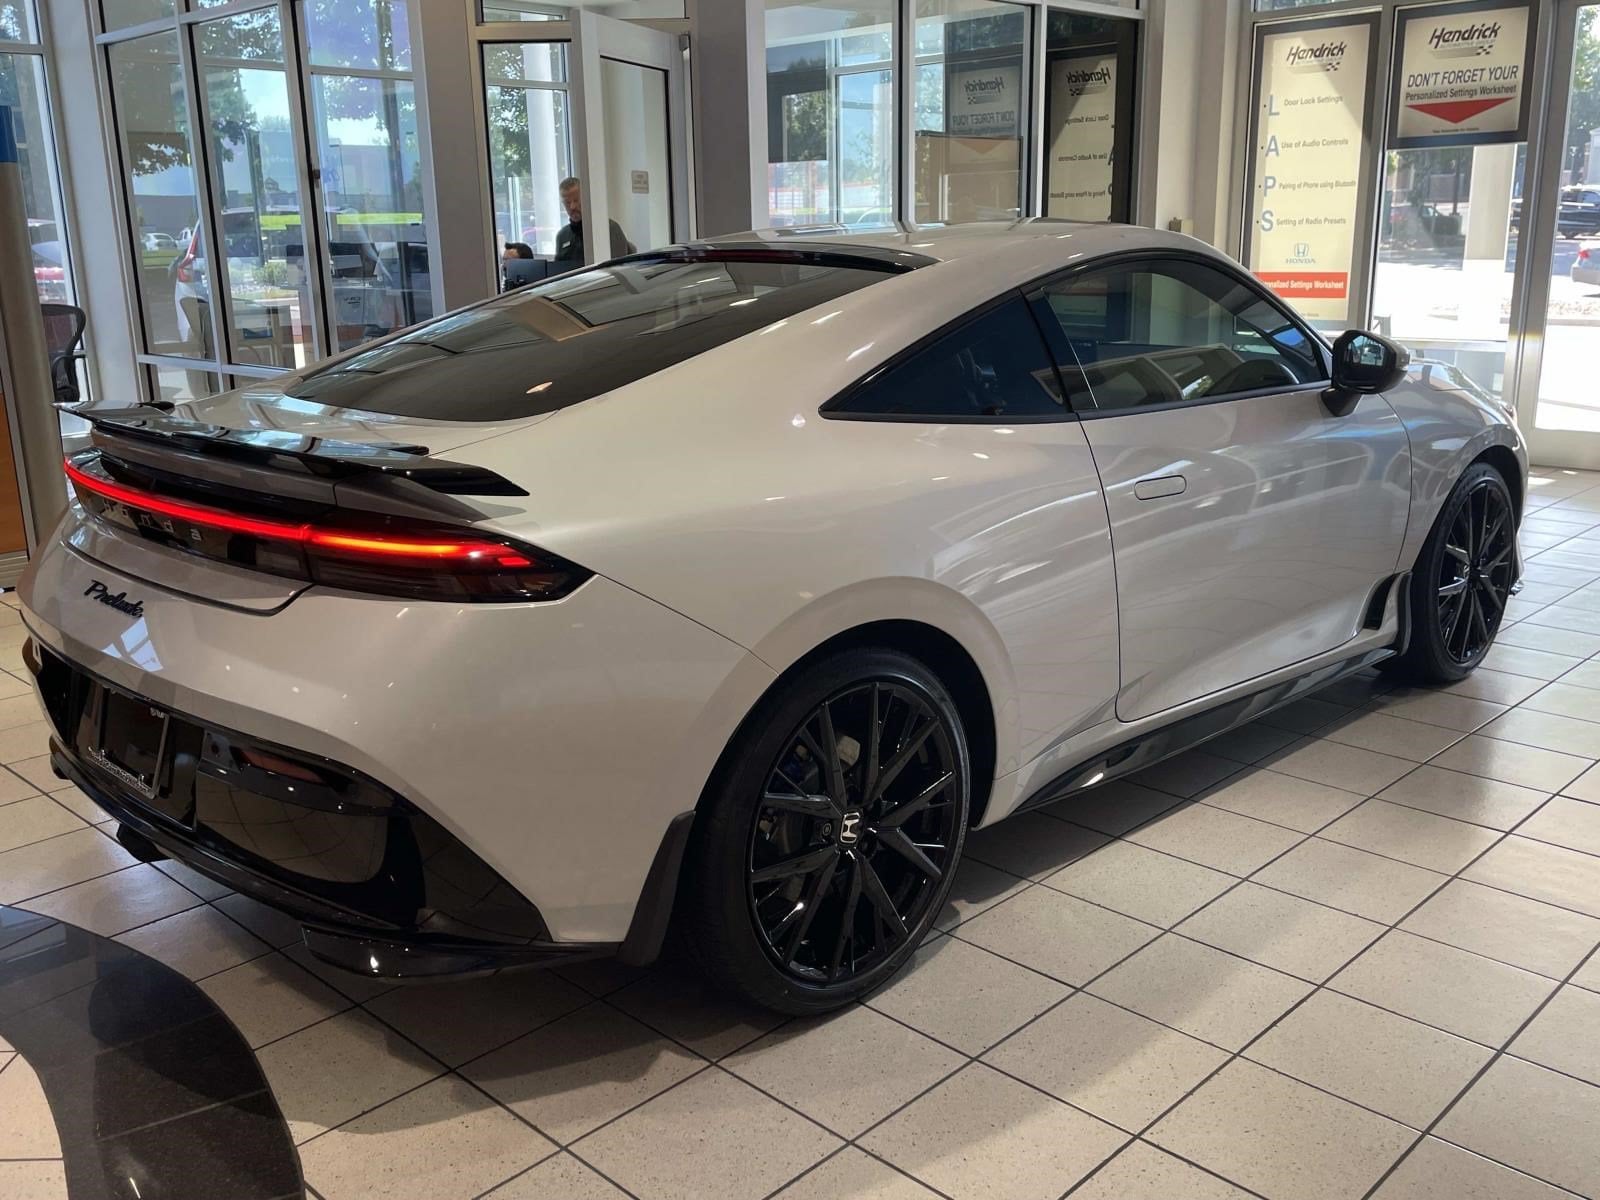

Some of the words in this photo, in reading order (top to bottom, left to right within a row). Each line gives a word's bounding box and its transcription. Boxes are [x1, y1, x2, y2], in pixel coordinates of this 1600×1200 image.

[1429, 22, 1501, 48] Hendrick
[1286, 41, 1347, 65] Hendrick
[1407, 72, 1440, 88] DON'T
[1441, 68, 1486, 85] FORGET
[1488, 65, 1519, 81] YOUR
[1284, 98, 1299, 106] Door
[1300, 97, 1315, 105] Lock
[1317, 95, 1343, 105] Settings
[1405, 90, 1448, 101] Personalized
[1449, 87, 1477, 98] Settings
[1479, 84, 1516, 95] Worksheet
[1268, 95, 1280, 116] L
[1265, 135, 1280, 158] A
[1321, 138, 1349, 146] Controls
[1263, 175, 1277, 198] P
[1261, 210, 1274, 232] S
[1276, 218, 1296, 226] Setting
[1305, 217, 1322, 225] Radio
[1290, 280, 1312, 291] Settings
[1314, 280, 1344, 289] Worksheet
[84, 579, 144, 618] Prelude
